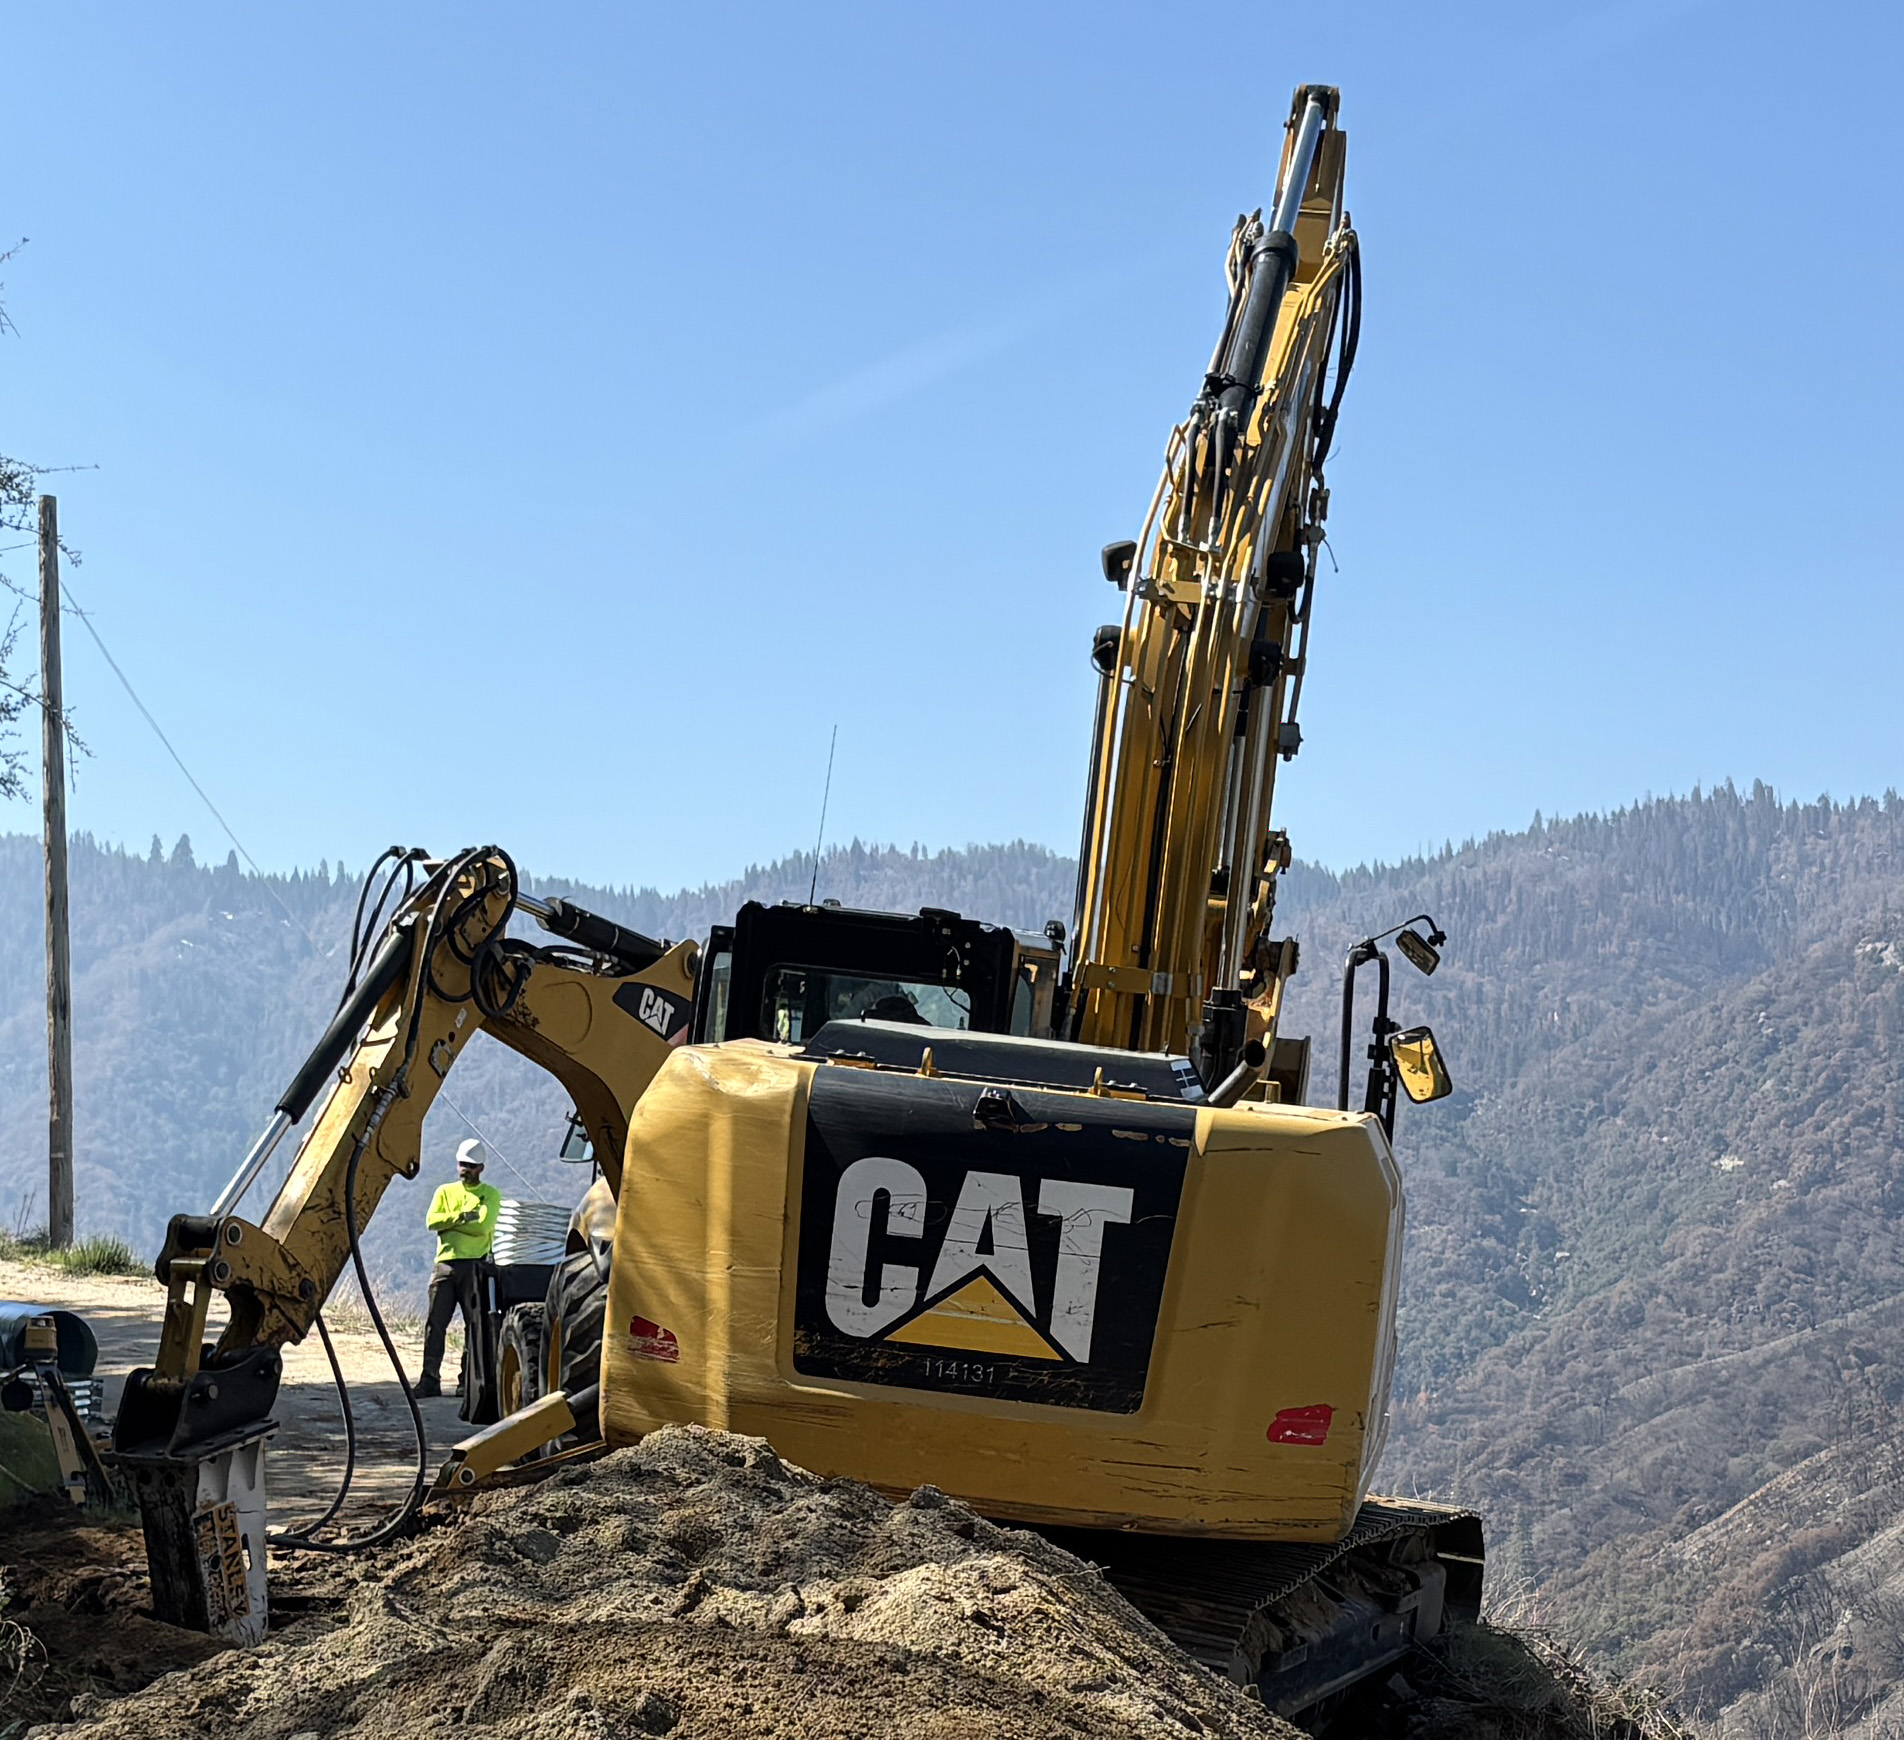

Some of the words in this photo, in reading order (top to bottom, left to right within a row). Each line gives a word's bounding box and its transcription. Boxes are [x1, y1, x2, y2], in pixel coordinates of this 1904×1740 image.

[639, 987, 675, 1036] CAT
[825, 1156, 1135, 1364] CAT
[922, 1358, 995, 1384] 114131
[217, 1504, 248, 1617] STANLEY
